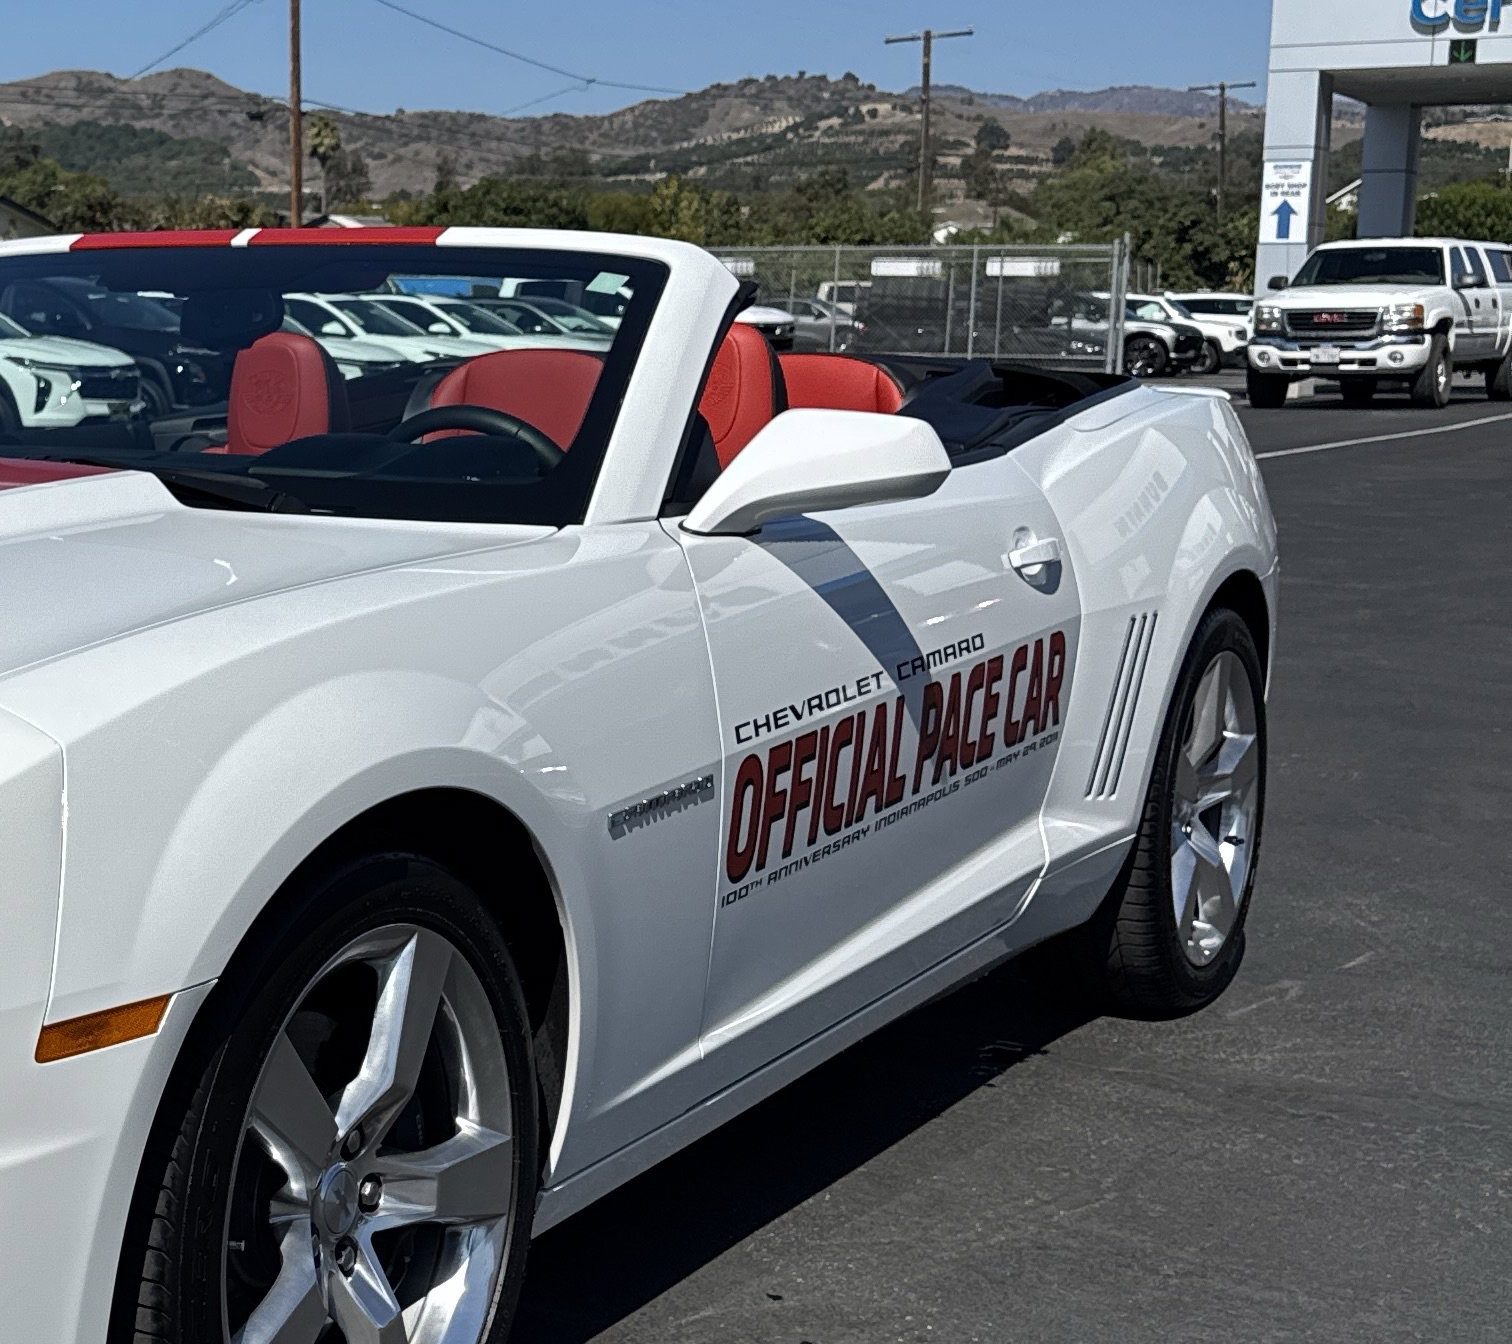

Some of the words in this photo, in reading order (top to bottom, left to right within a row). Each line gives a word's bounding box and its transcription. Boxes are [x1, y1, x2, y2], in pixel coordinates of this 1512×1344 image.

[726, 694, 906, 884] OFFICIAL
[911, 654, 1004, 795] PACE
[1003, 630, 1066, 748] CAR
[734, 670, 884, 745] CHEVROLET
[896, 633, 985, 681] CAMARO
[721, 878, 762, 908] 100TH
[767, 824, 870, 885] ANNIVERSARY
[874, 780, 961, 833] INDIANAPOLIS
[964, 766, 988, 786] 500
[996, 750, 1020, 770] MAY
